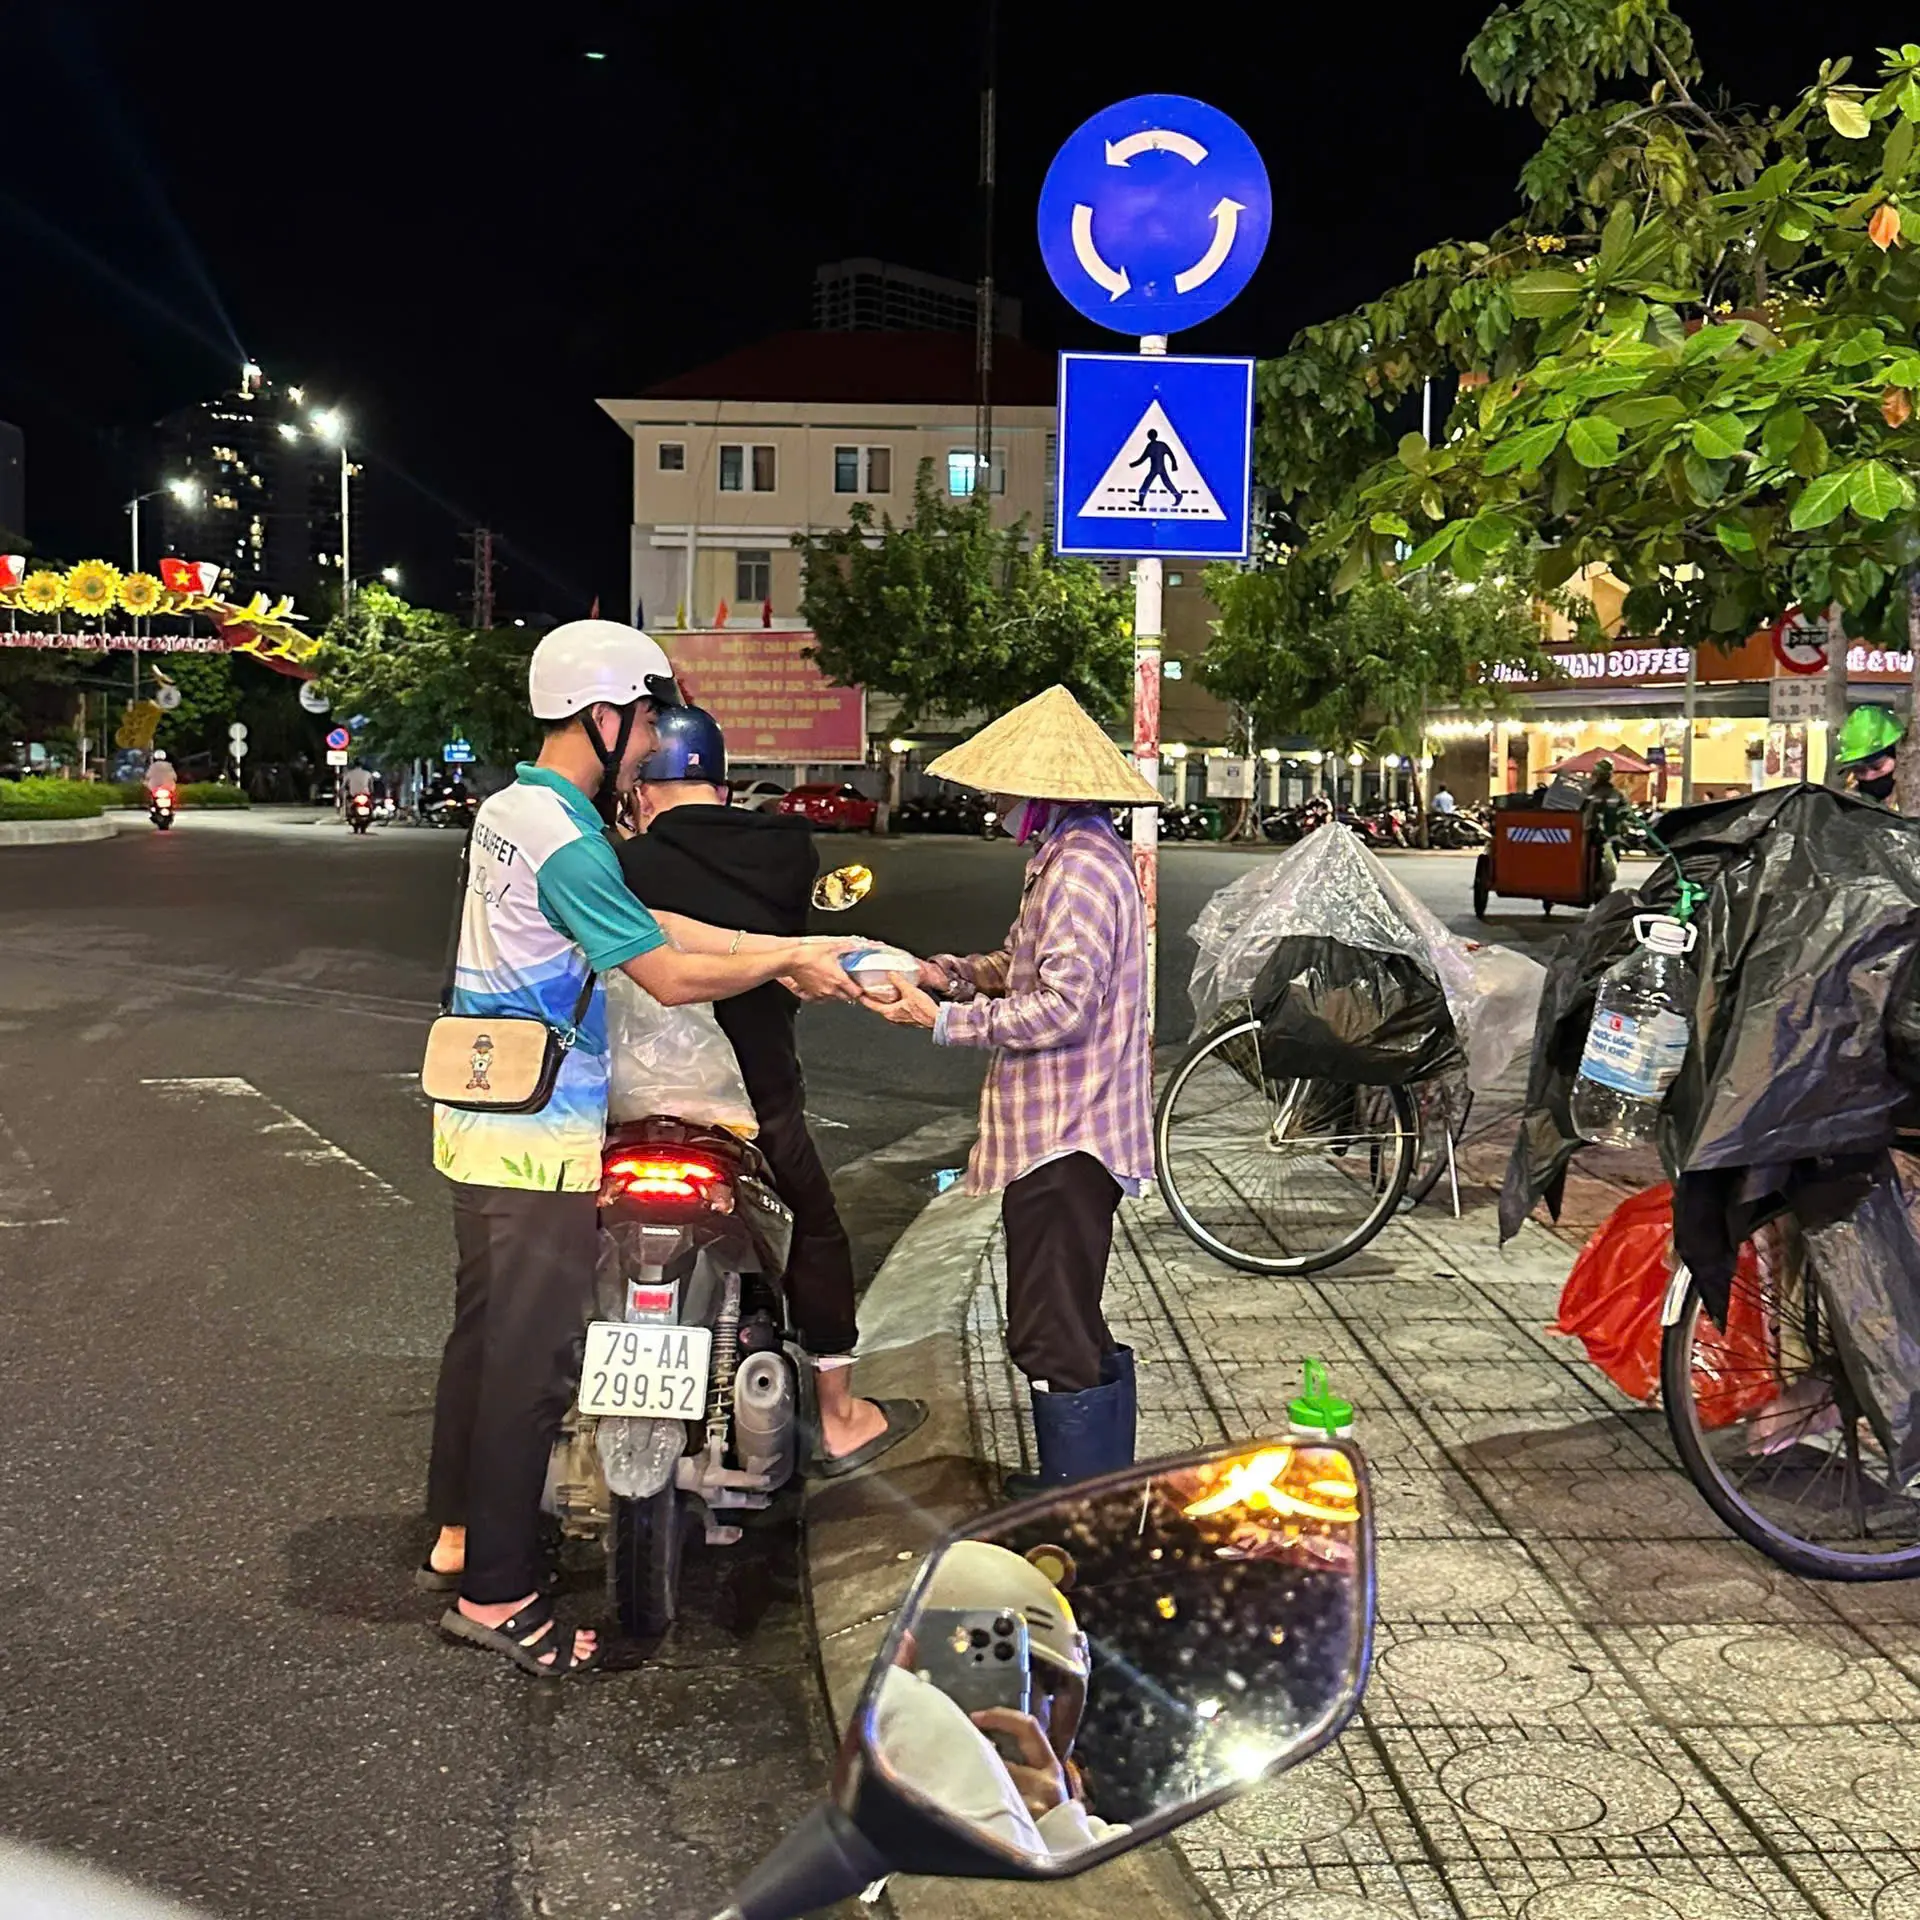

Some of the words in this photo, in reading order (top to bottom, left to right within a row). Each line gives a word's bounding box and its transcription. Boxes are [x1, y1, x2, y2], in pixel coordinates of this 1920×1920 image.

[1607, 647, 1690, 678] COFFEE
[482, 827, 518, 866] BUFFET
[603, 1330, 689, 1370] 79-AA
[591, 1371, 696, 1412] 299.52
